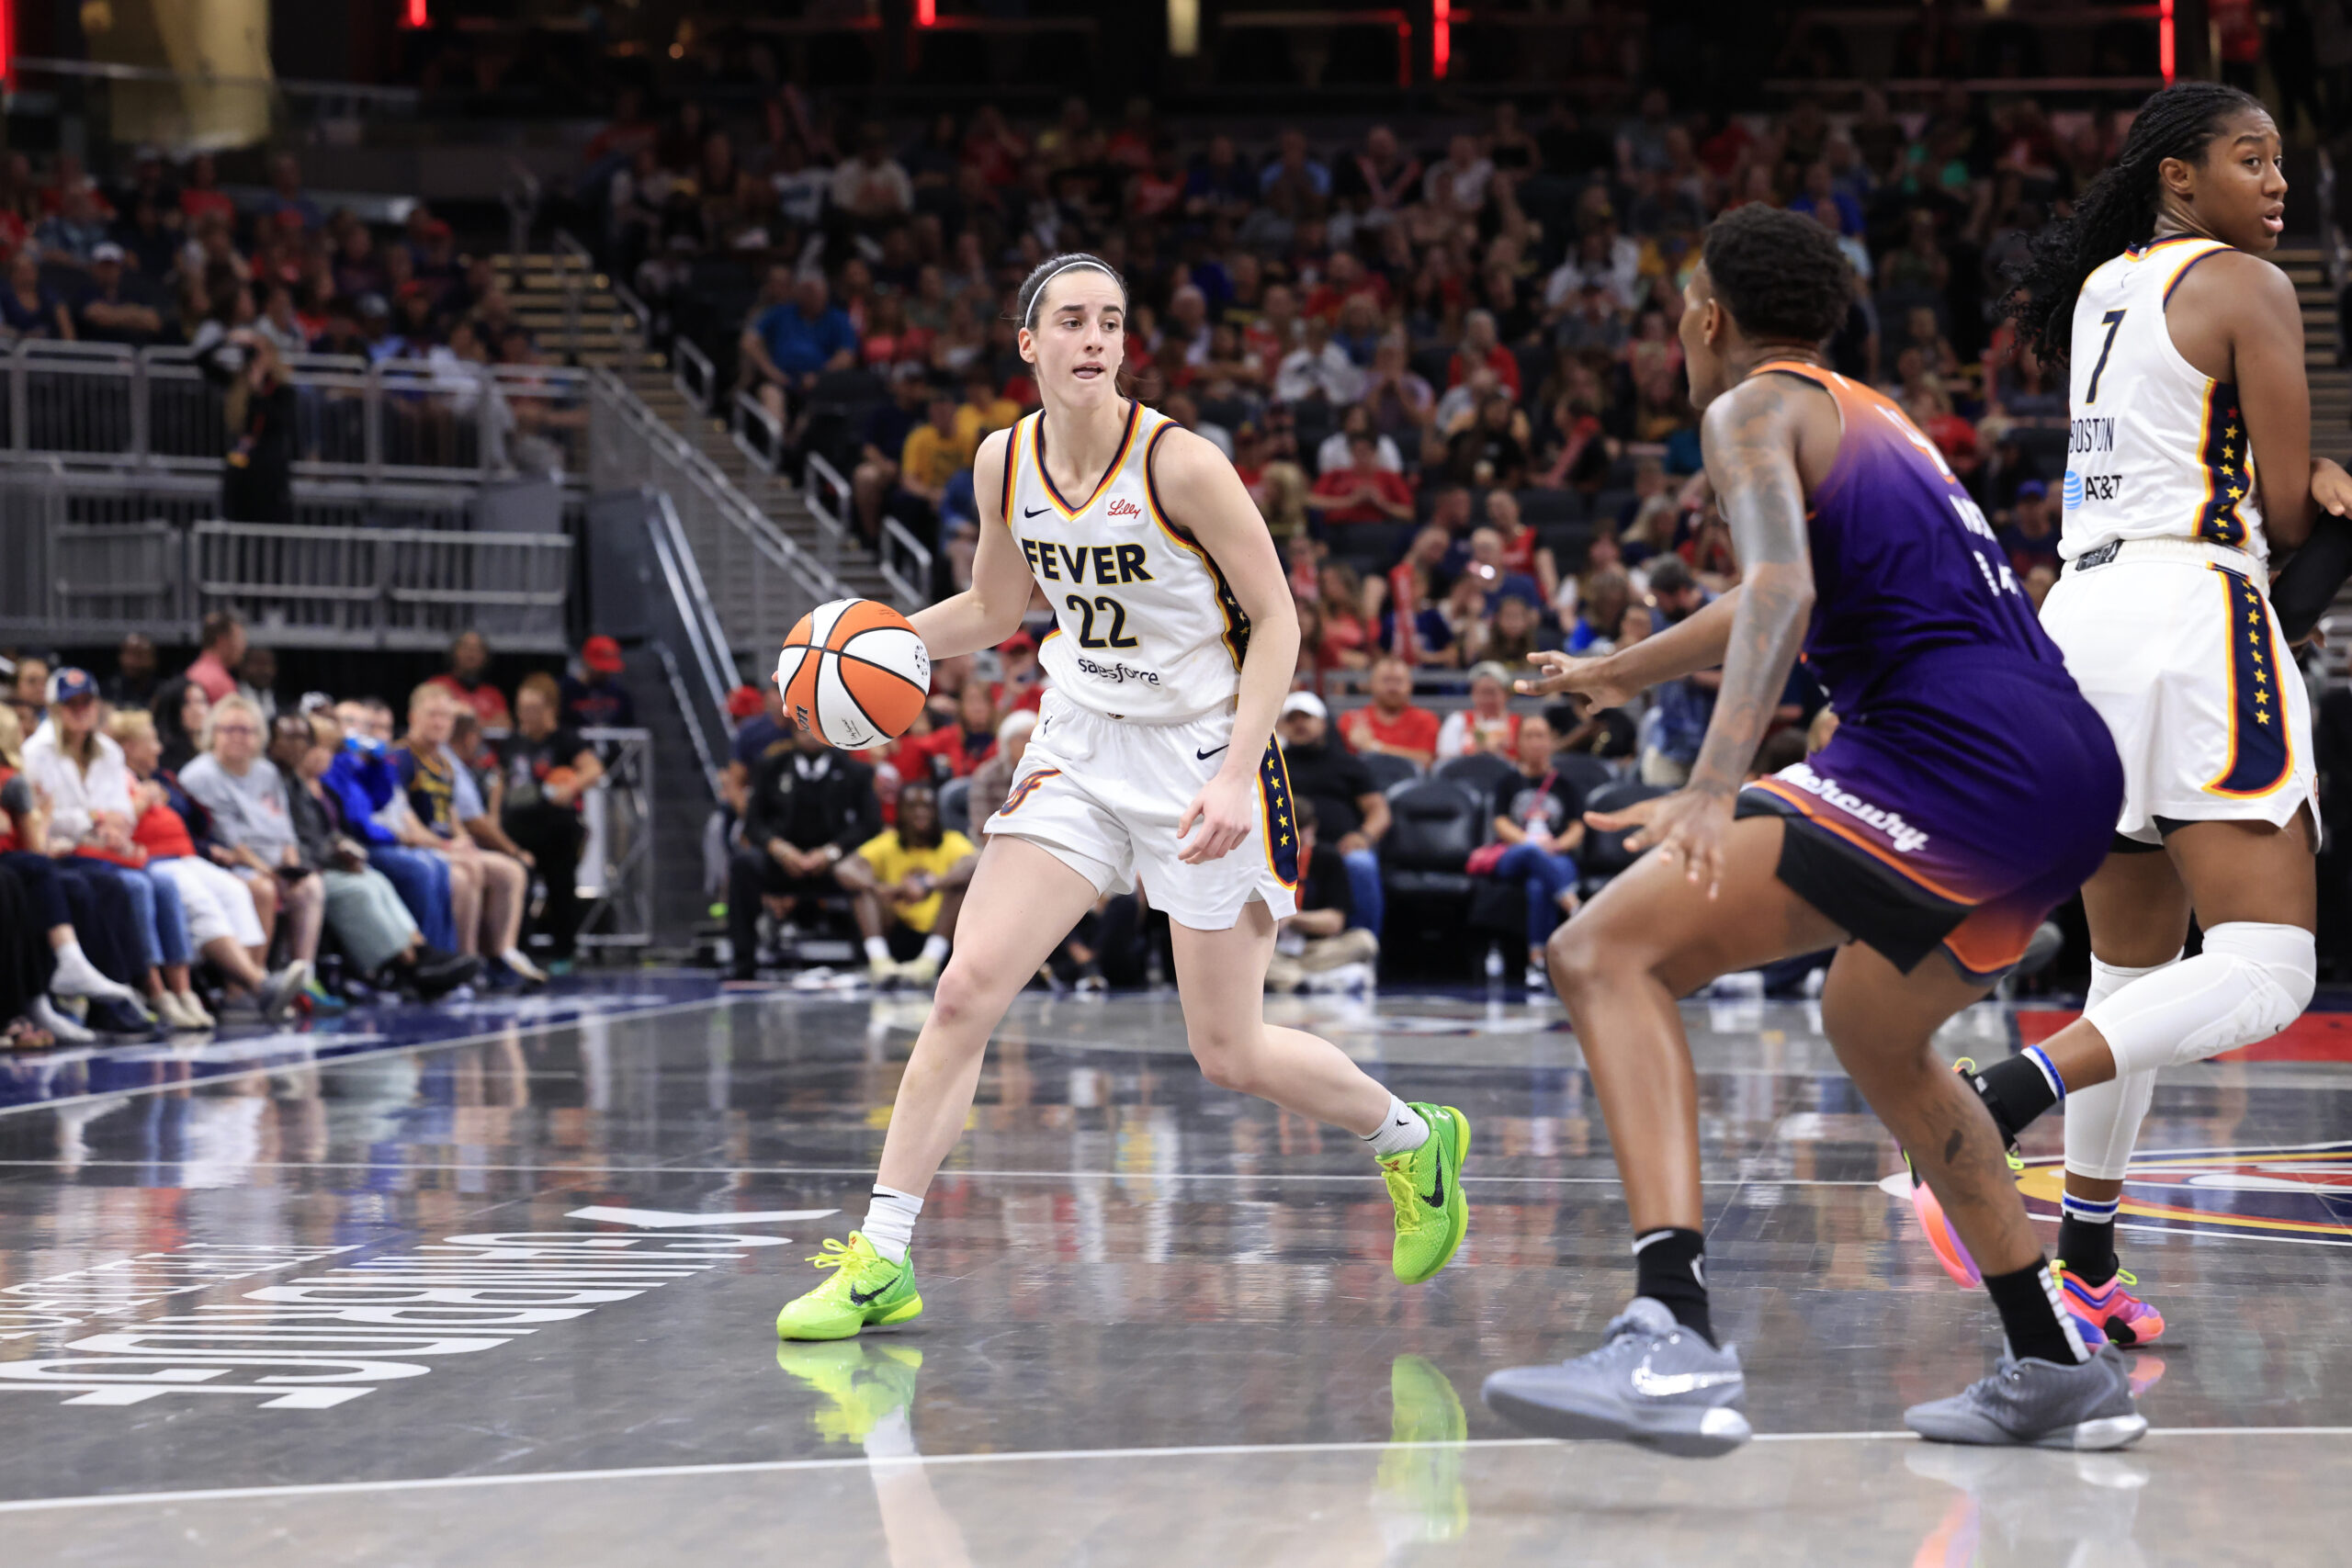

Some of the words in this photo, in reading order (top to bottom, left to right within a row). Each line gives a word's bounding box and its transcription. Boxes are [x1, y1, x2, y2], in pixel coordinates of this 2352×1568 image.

[2086, 308, 2128, 405] 7
[1107, 499, 1142, 519] Lilly
[2085, 475, 2123, 501] AT&T
[1021, 537, 1156, 585] FEVER
[1066, 593, 1139, 649] 22
[1078, 658, 1160, 685] saesforce
[0, 1232, 793, 1408] GAINBRIDGE
